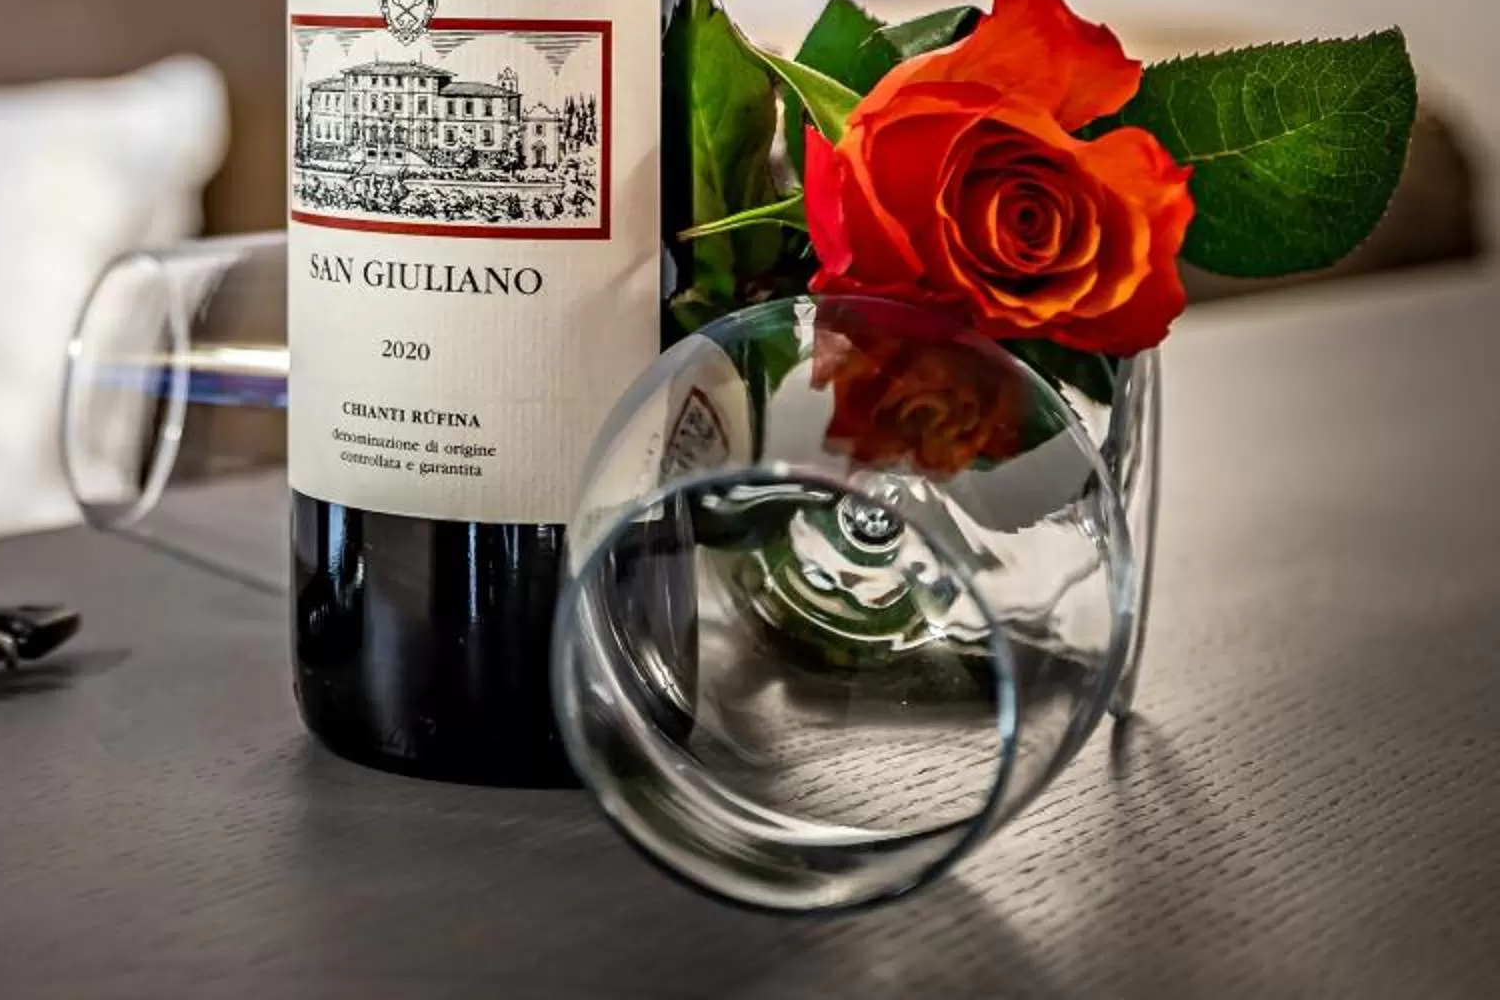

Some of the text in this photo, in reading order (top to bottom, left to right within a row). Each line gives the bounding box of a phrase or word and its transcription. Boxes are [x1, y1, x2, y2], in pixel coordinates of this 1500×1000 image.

[309, 253, 543, 296] SAN GIULIANO
[381, 340, 431, 361] 2020
[342, 401, 406, 423] CHIANTI
[331, 428, 497, 458] denominazione di origine
[339, 451, 483, 477] controllata e garantita
